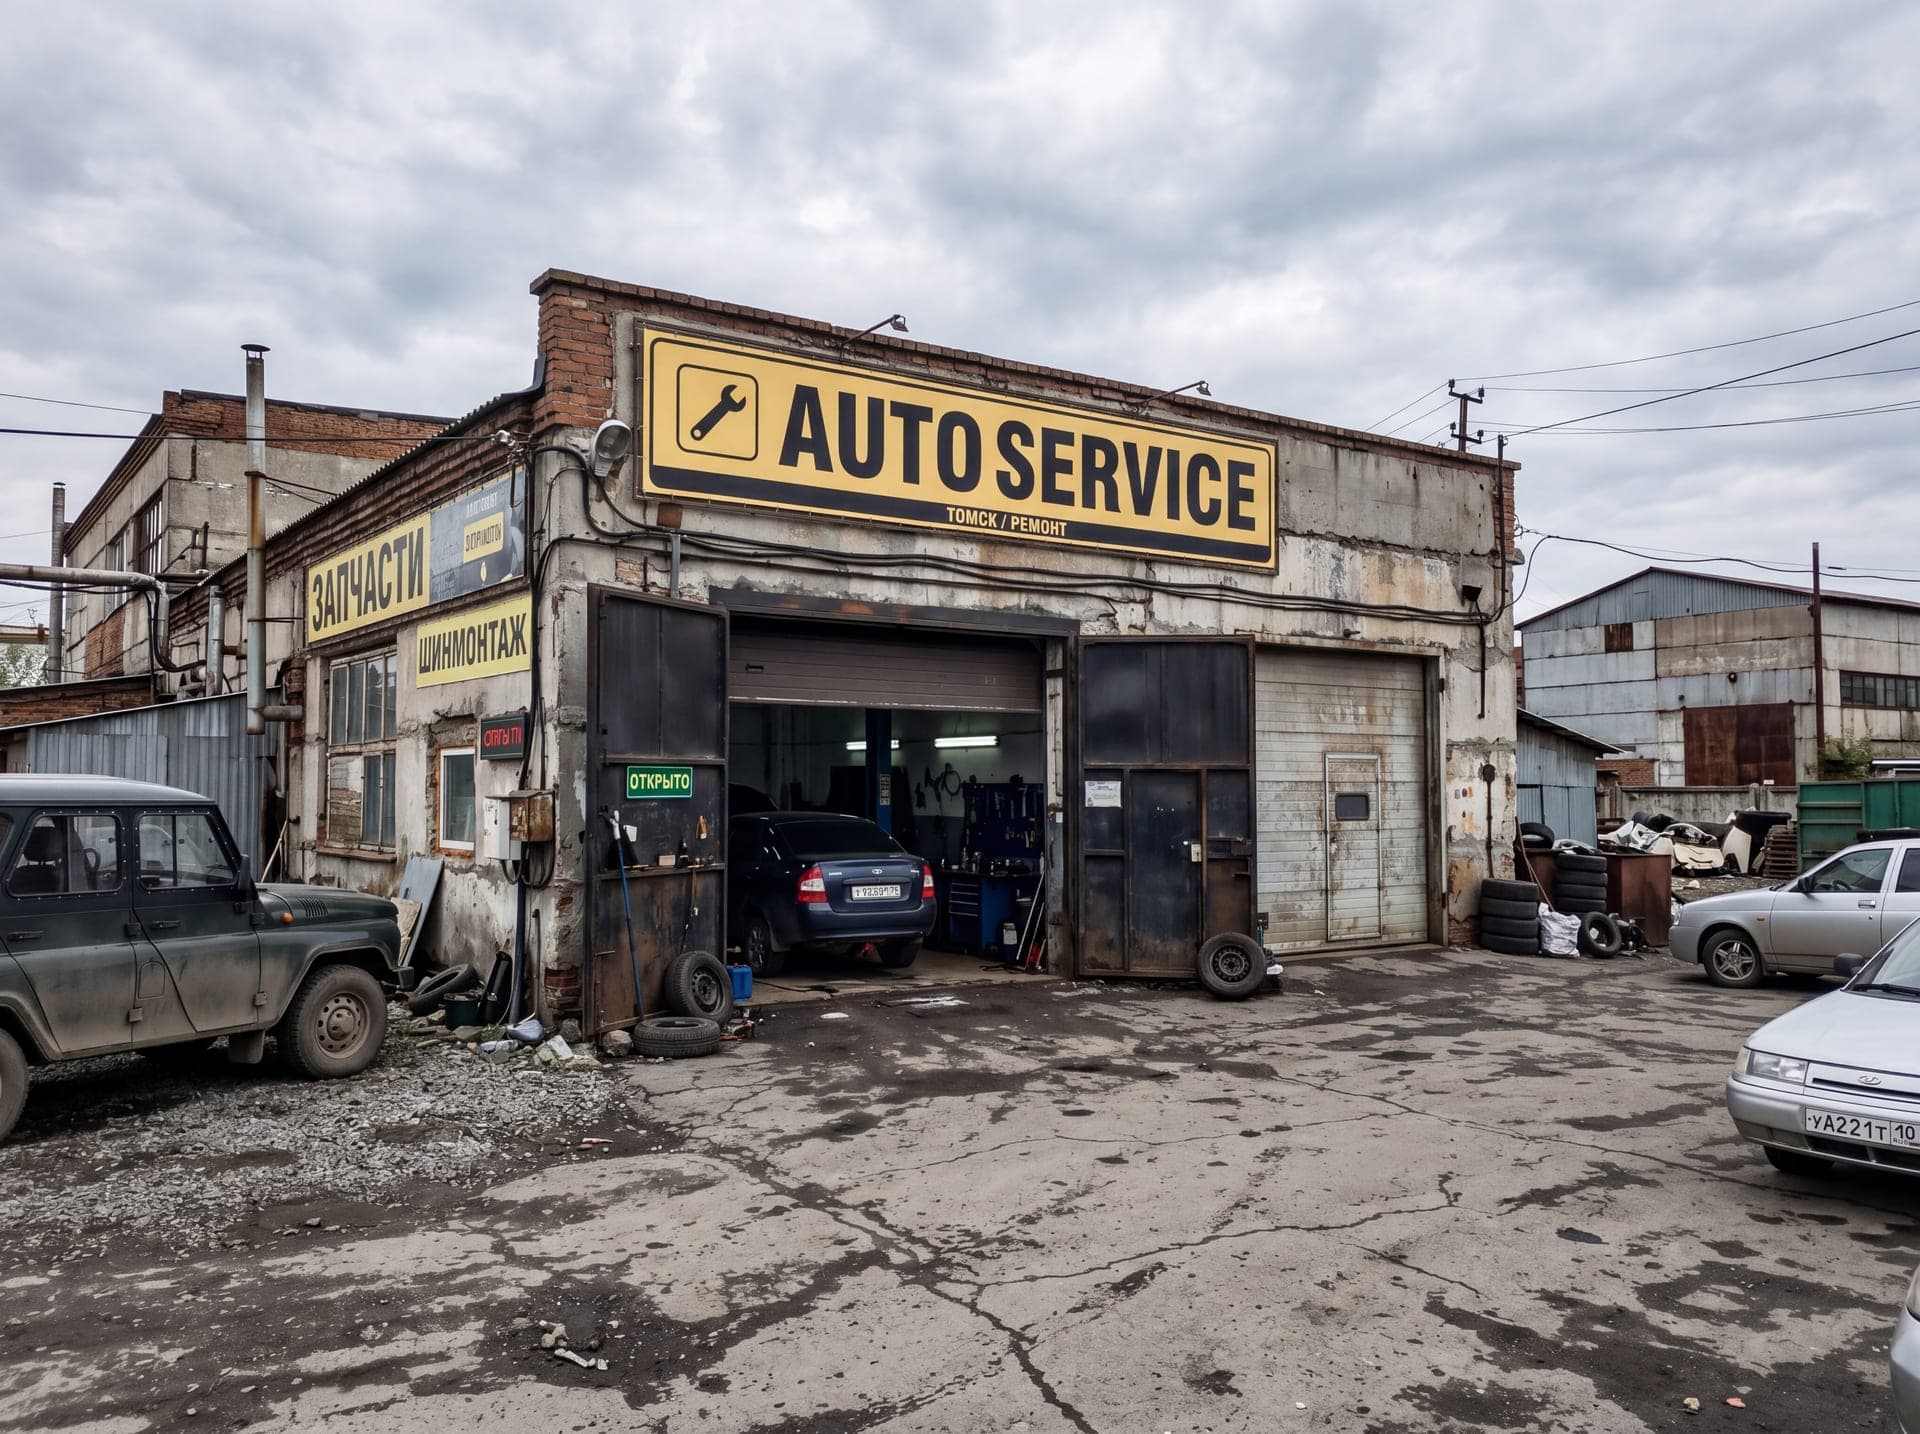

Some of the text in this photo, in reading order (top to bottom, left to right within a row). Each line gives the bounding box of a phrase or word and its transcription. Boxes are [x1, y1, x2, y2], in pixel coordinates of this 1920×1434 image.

[779, 384, 1256, 530] AUTO SERVICE
[947, 507, 997, 528] ТОМСК
[1011, 515, 1067, 536] РЕМОНТ
[313, 527, 424, 631] ЗАПЧАСТИ
[419, 613, 527, 674] ШИНМОНТАЖ
[630, 773, 690, 790] ОТКРЫТО
